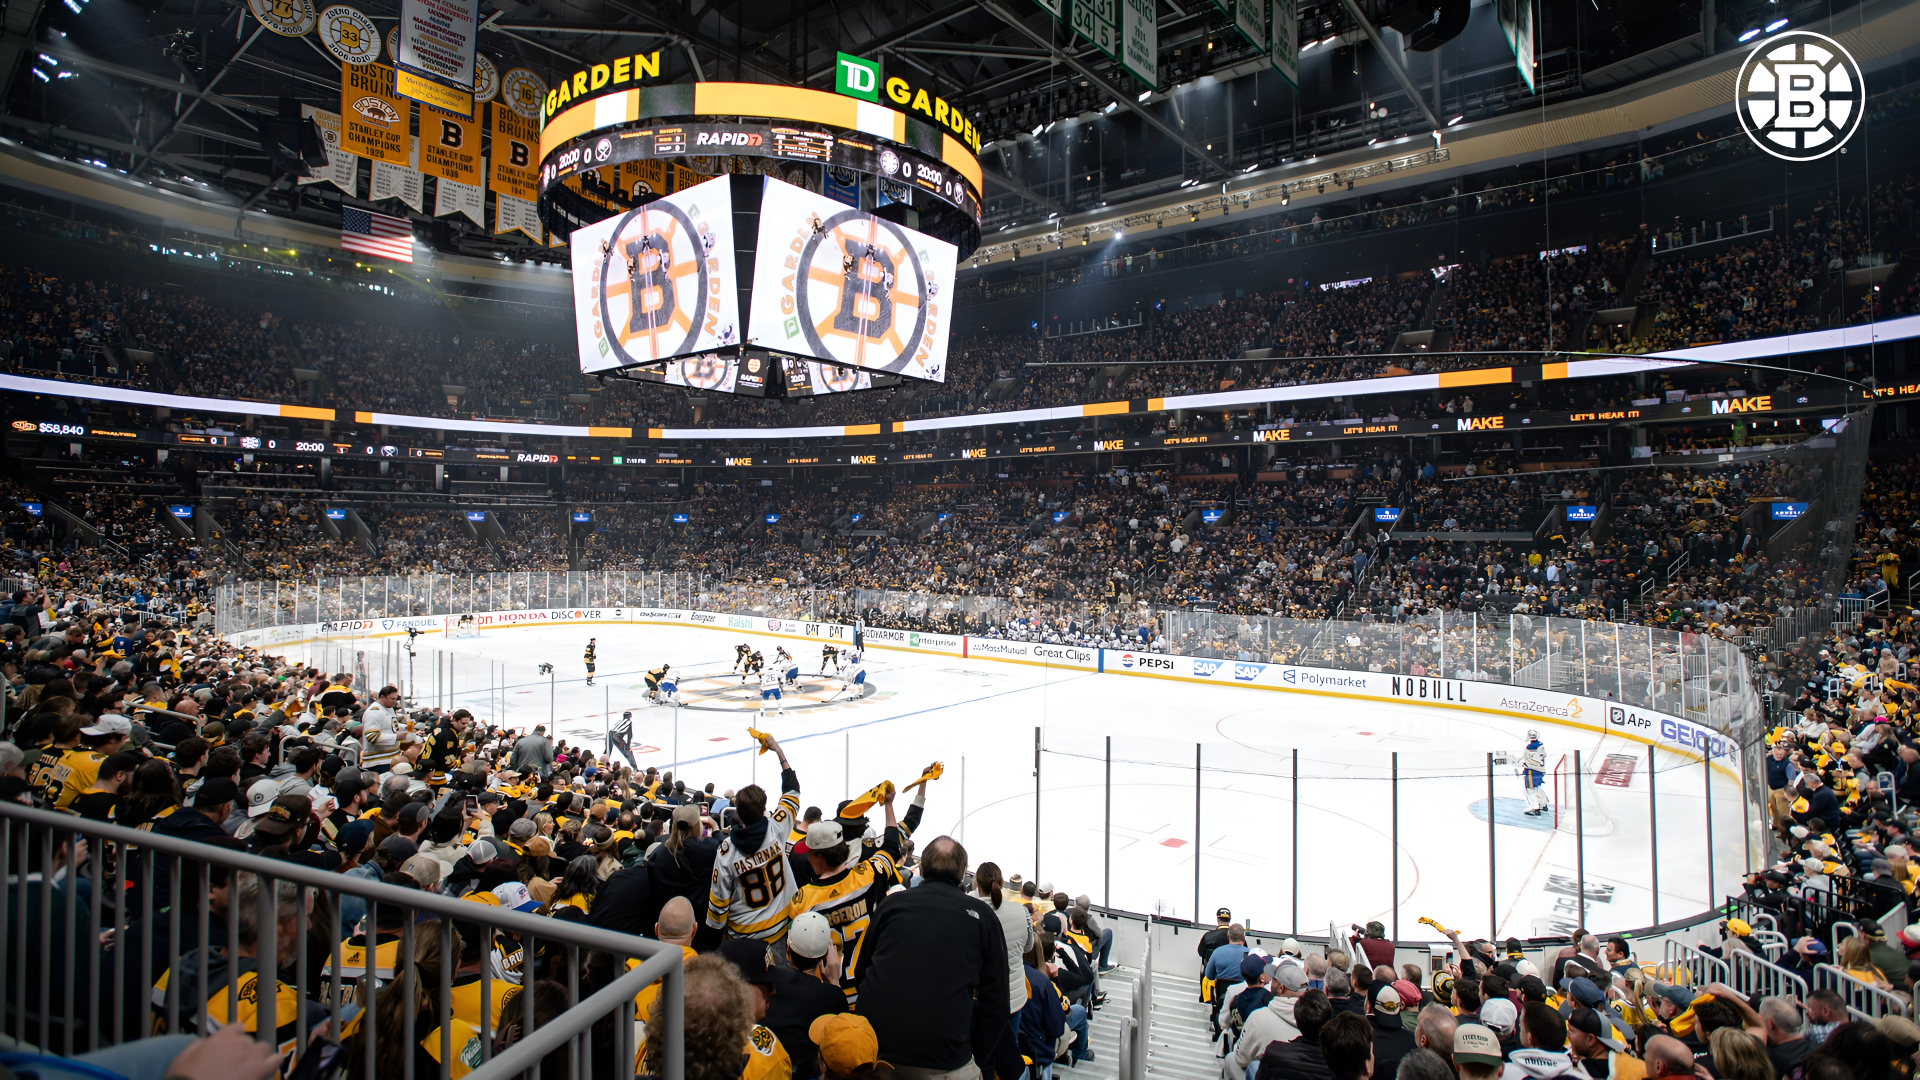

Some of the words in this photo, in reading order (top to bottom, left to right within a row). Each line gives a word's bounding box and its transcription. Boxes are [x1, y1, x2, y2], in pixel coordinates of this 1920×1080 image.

[1073, 3, 1093, 35] 34
[341, 29, 358, 43] 33
[1101, 25, 1109, 47] 5
[546, 51, 660, 117] GARDEN
[521, 87, 532, 102] 16
[840, 60, 876, 93] TD
[886, 77, 981, 156] GARDEN
[348, 121, 384, 139] STANLEY
[348, 131, 401, 153] CHAMPIONS
[695, 131, 764, 147] RAPID7
[558, 147, 581, 170] 20:00
[583, 147, 592, 164] 0
[902, 161, 912, 178] 0
[916, 163, 943, 187] 20:00
[945, 180, 952, 197] 0
[1862, 388, 1895, 400] LT'S
[1711, 395, 1772, 415] MAKE
[1569, 413, 1596, 422] LET'S
[1598, 411, 1625, 421] HEAR
[1627, 410, 1641, 419] IT!
[38, 422, 84, 437] $58,840
[1365, 425, 1386, 434] HEAR
[1457, 415, 1505, 432] MAKE
[209, 436, 218, 446] 0
[1252, 429, 1290, 443] MAKE
[267, 439, 277, 449] 0
[295, 441, 325, 453] 20:00
[365, 446, 375, 456] 0
[1094, 440, 1124, 452] MAKE
[516, 453, 559, 464] RAPID7
[850, 455, 877, 466] MAKE
[962, 448, 987, 461] MAKE
[725, 457, 752, 467] MAKE
[498, 612, 548, 623] HONDA
[551, 610, 602, 620] DISCOVER
[728, 615, 753, 630] Kalshi
[805, 623, 820, 637] CAT
[829, 625, 844, 639] CAT
[1033, 645, 1063, 662] Great
[1065, 648, 1091, 666] Clips
[1139, 657, 1174, 671] PEPSI
[1194, 661, 1218, 674] SAP
[765, 673, 776, 684] 26
[1235, 665, 1260, 679] SAP
[1300, 671, 1368, 692] Polymarket
[1499, 698, 1569, 717] AstraZeneca
[733, 842, 783, 877] PASTRNAK
[739, 854, 786, 911] 88
